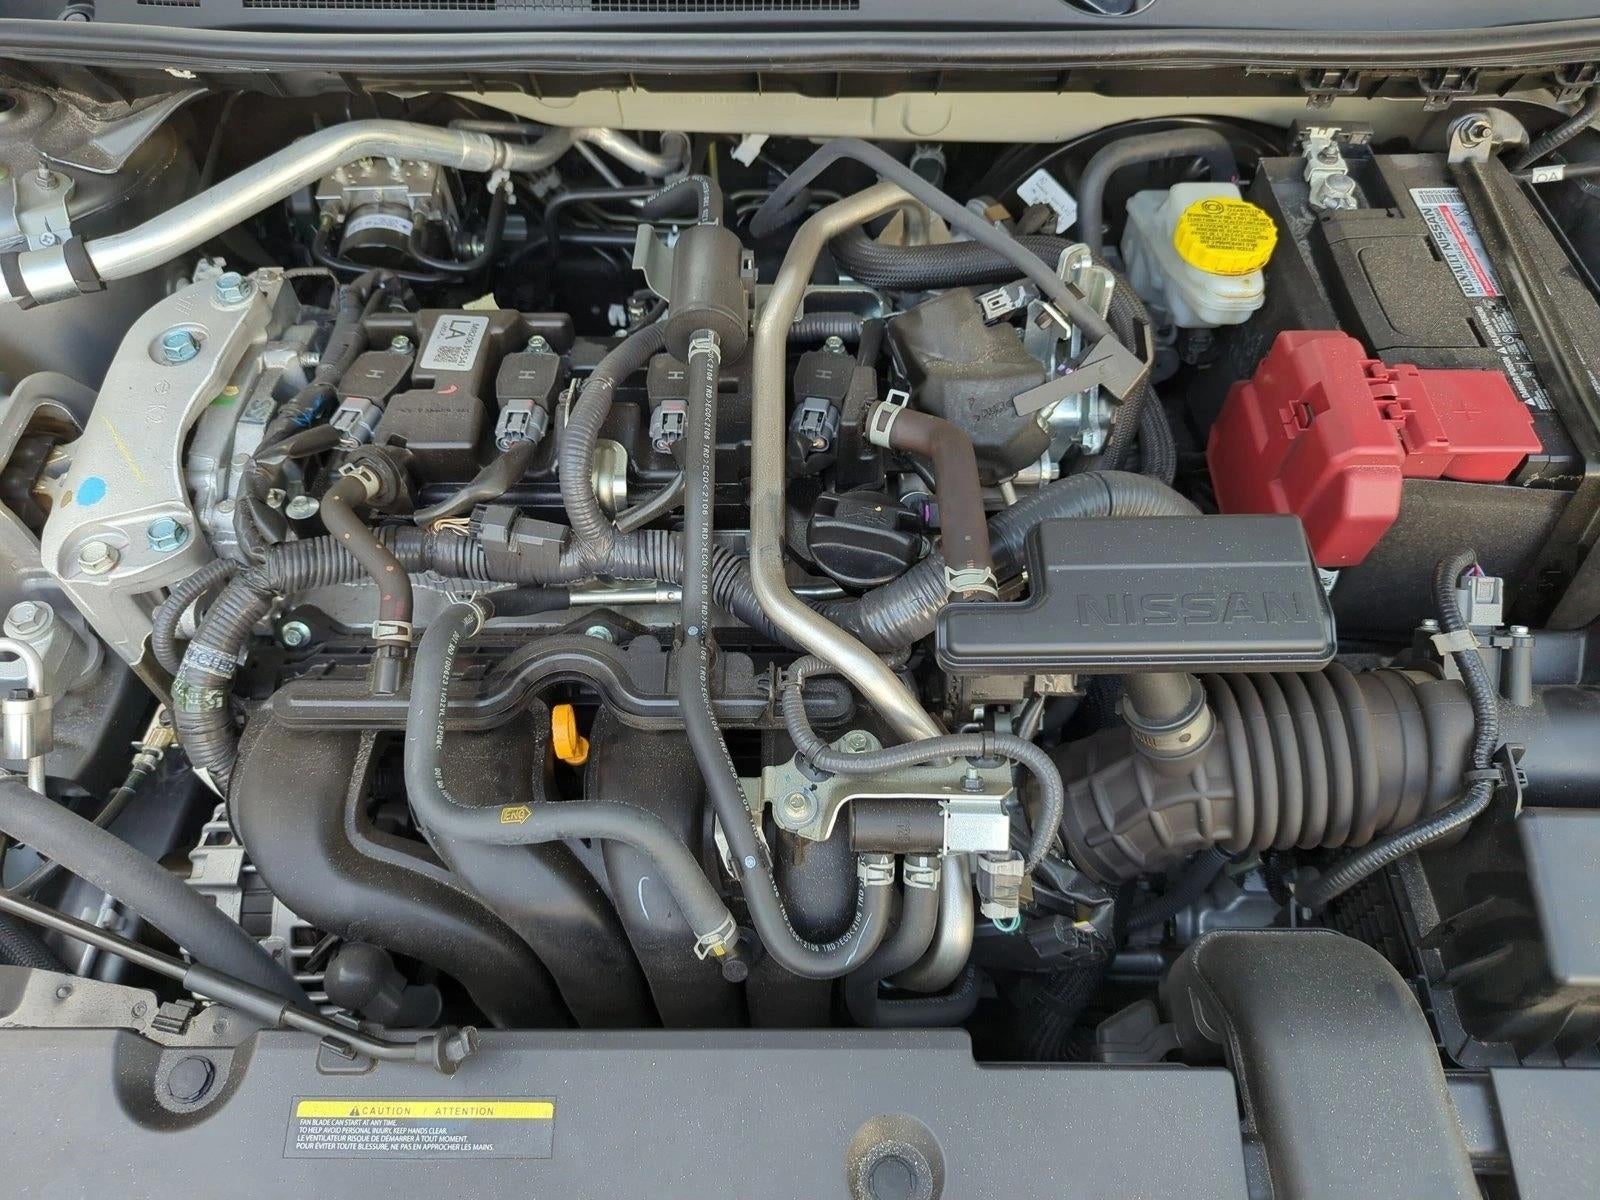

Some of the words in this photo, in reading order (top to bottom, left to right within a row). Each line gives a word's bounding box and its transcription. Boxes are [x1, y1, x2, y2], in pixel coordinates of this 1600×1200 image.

[1421, 207, 1453, 251] NISSAN
[1446, 254, 1477, 294] RENAULT
[447, 319, 471, 340] LA
[1075, 591, 1310, 627] NISSAN
[362, 1106, 411, 1115] CAUTION
[435, 1107, 494, 1116] ATTENTION
[439, 1135, 469, 1143] MOMENT.
[460, 1143, 472, 1151] LES
